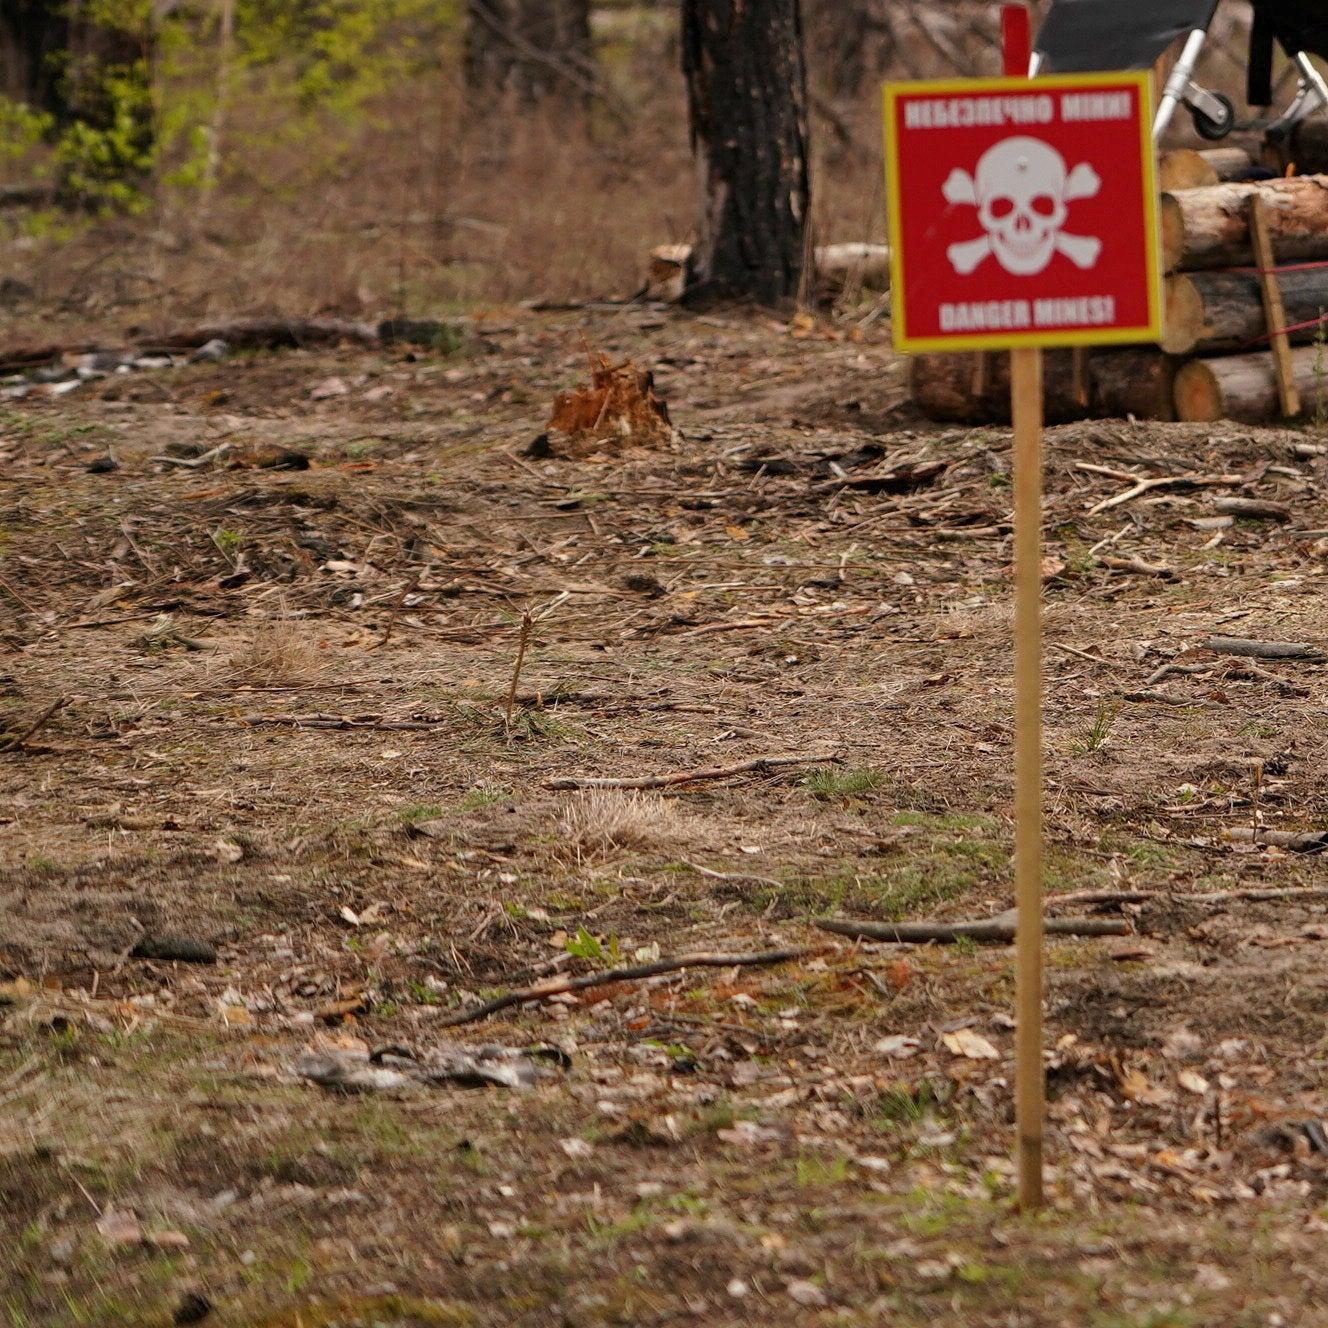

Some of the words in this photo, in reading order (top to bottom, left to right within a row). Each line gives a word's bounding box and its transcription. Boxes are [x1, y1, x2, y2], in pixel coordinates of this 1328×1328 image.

[904, 95, 1054, 130] НЕБЕЗПЕЧНО
[938, 299, 1031, 332] DANGER
[1033, 295, 1115, 325] MINES!
